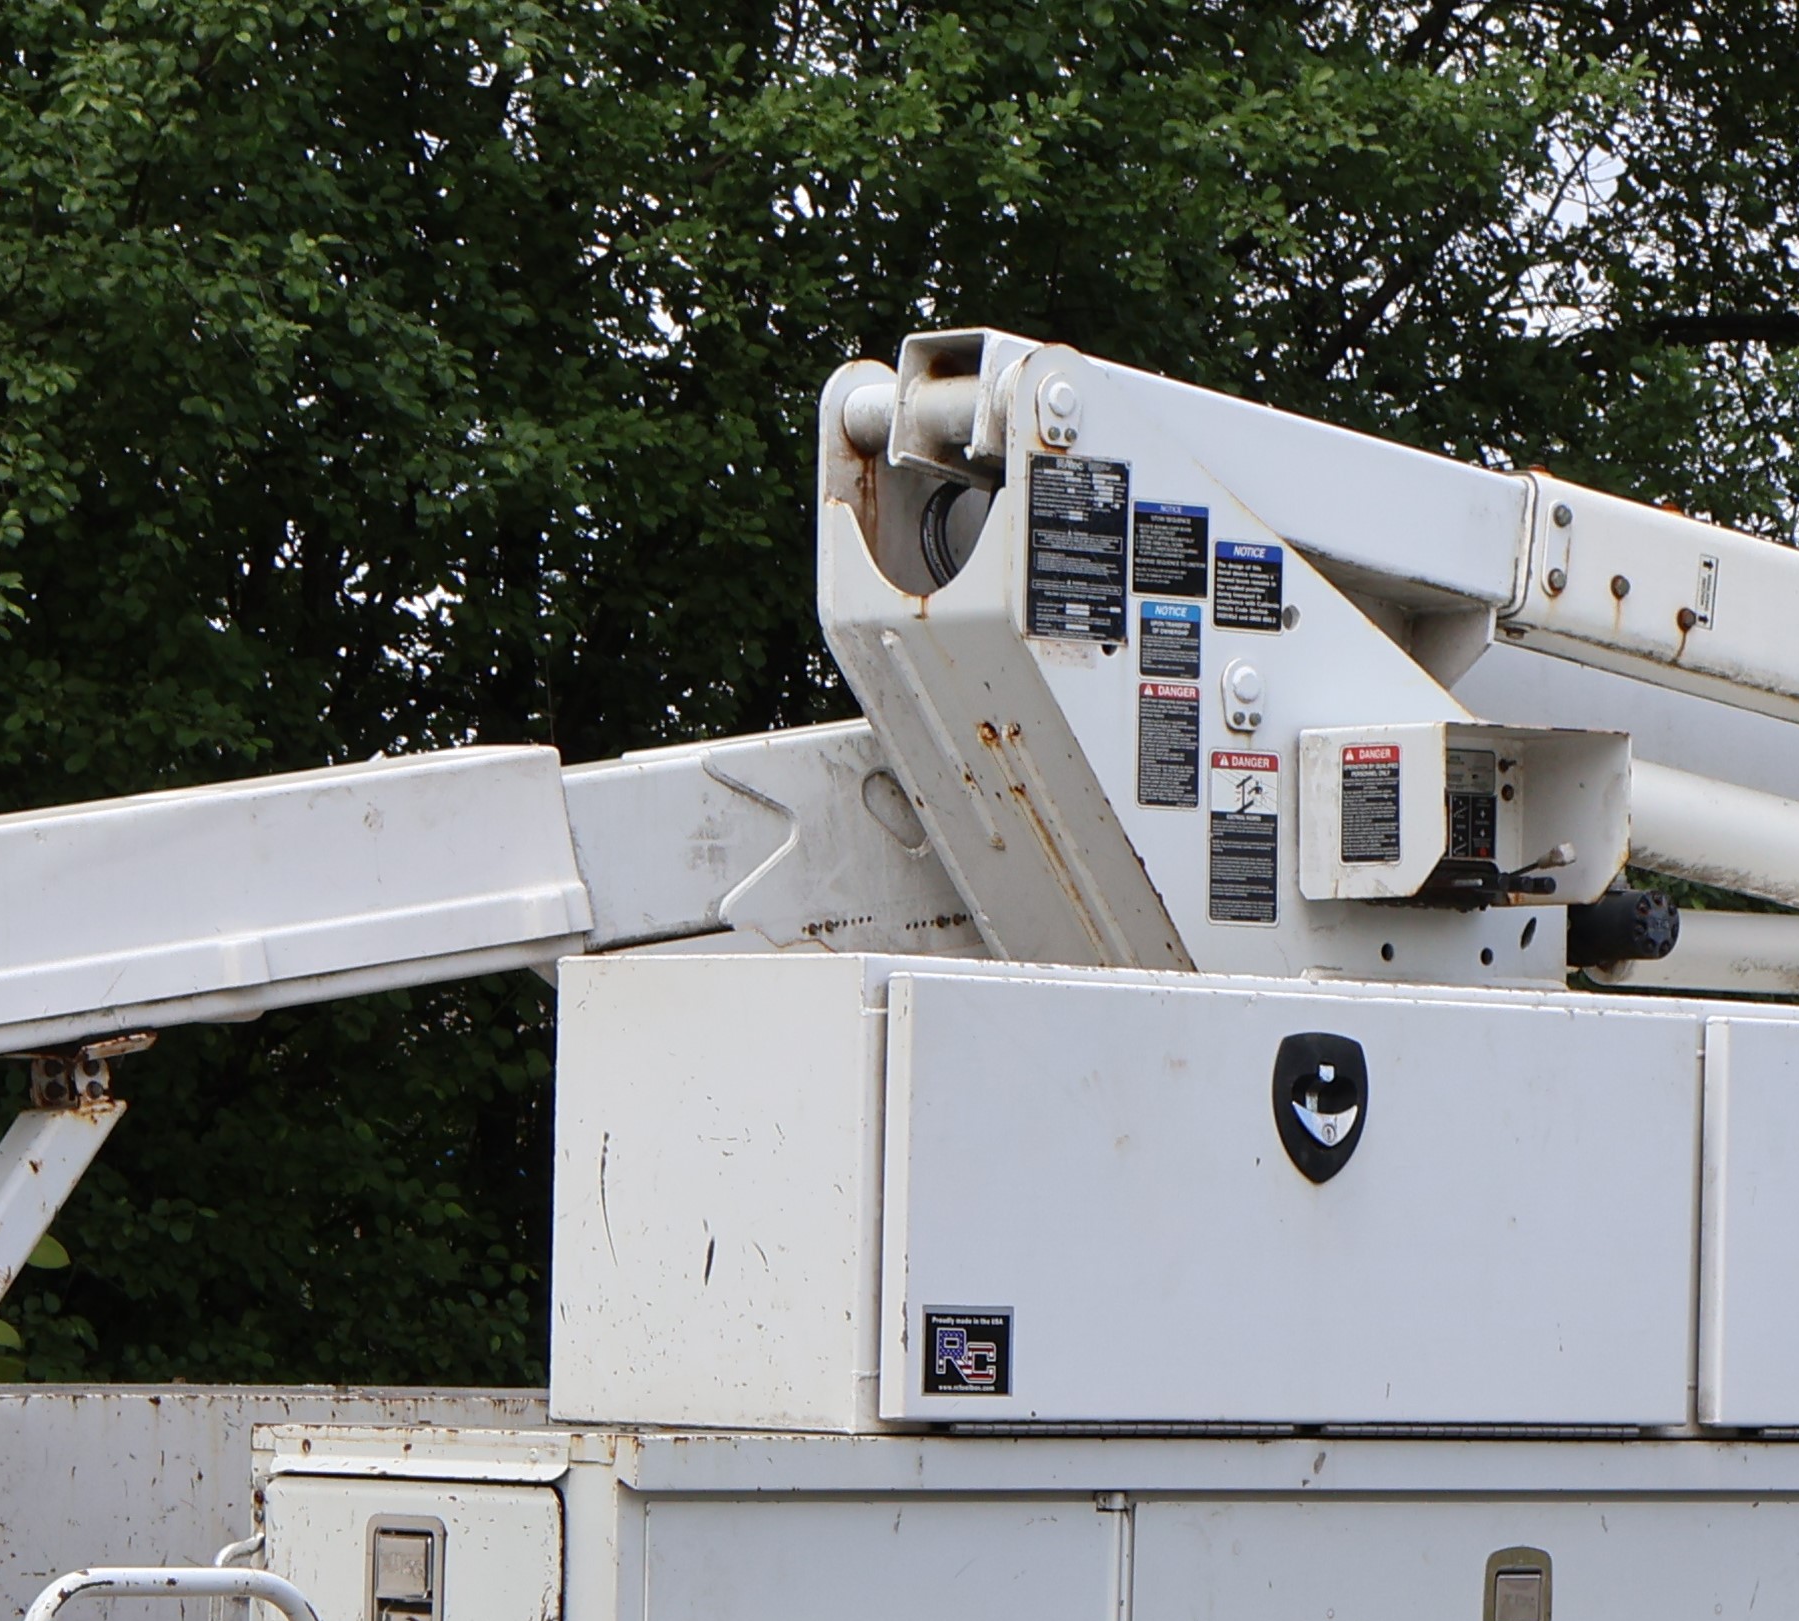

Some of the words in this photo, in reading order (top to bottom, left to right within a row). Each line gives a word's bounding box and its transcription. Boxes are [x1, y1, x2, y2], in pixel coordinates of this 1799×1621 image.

[1160, 505, 1181, 513] NOTICE
[1234, 546, 1266, 558] NOTICE
[1155, 606, 1187, 617] NOTICE
[1158, 686, 1196, 697] DANGER
[1359, 748, 1391, 759] DANGER
[1232, 756, 1269, 768] DANGER
[932, 1317, 954, 1325] Proudly
[991, 1317, 1003, 1325] USA
[936, 1328, 996, 1384] RC
